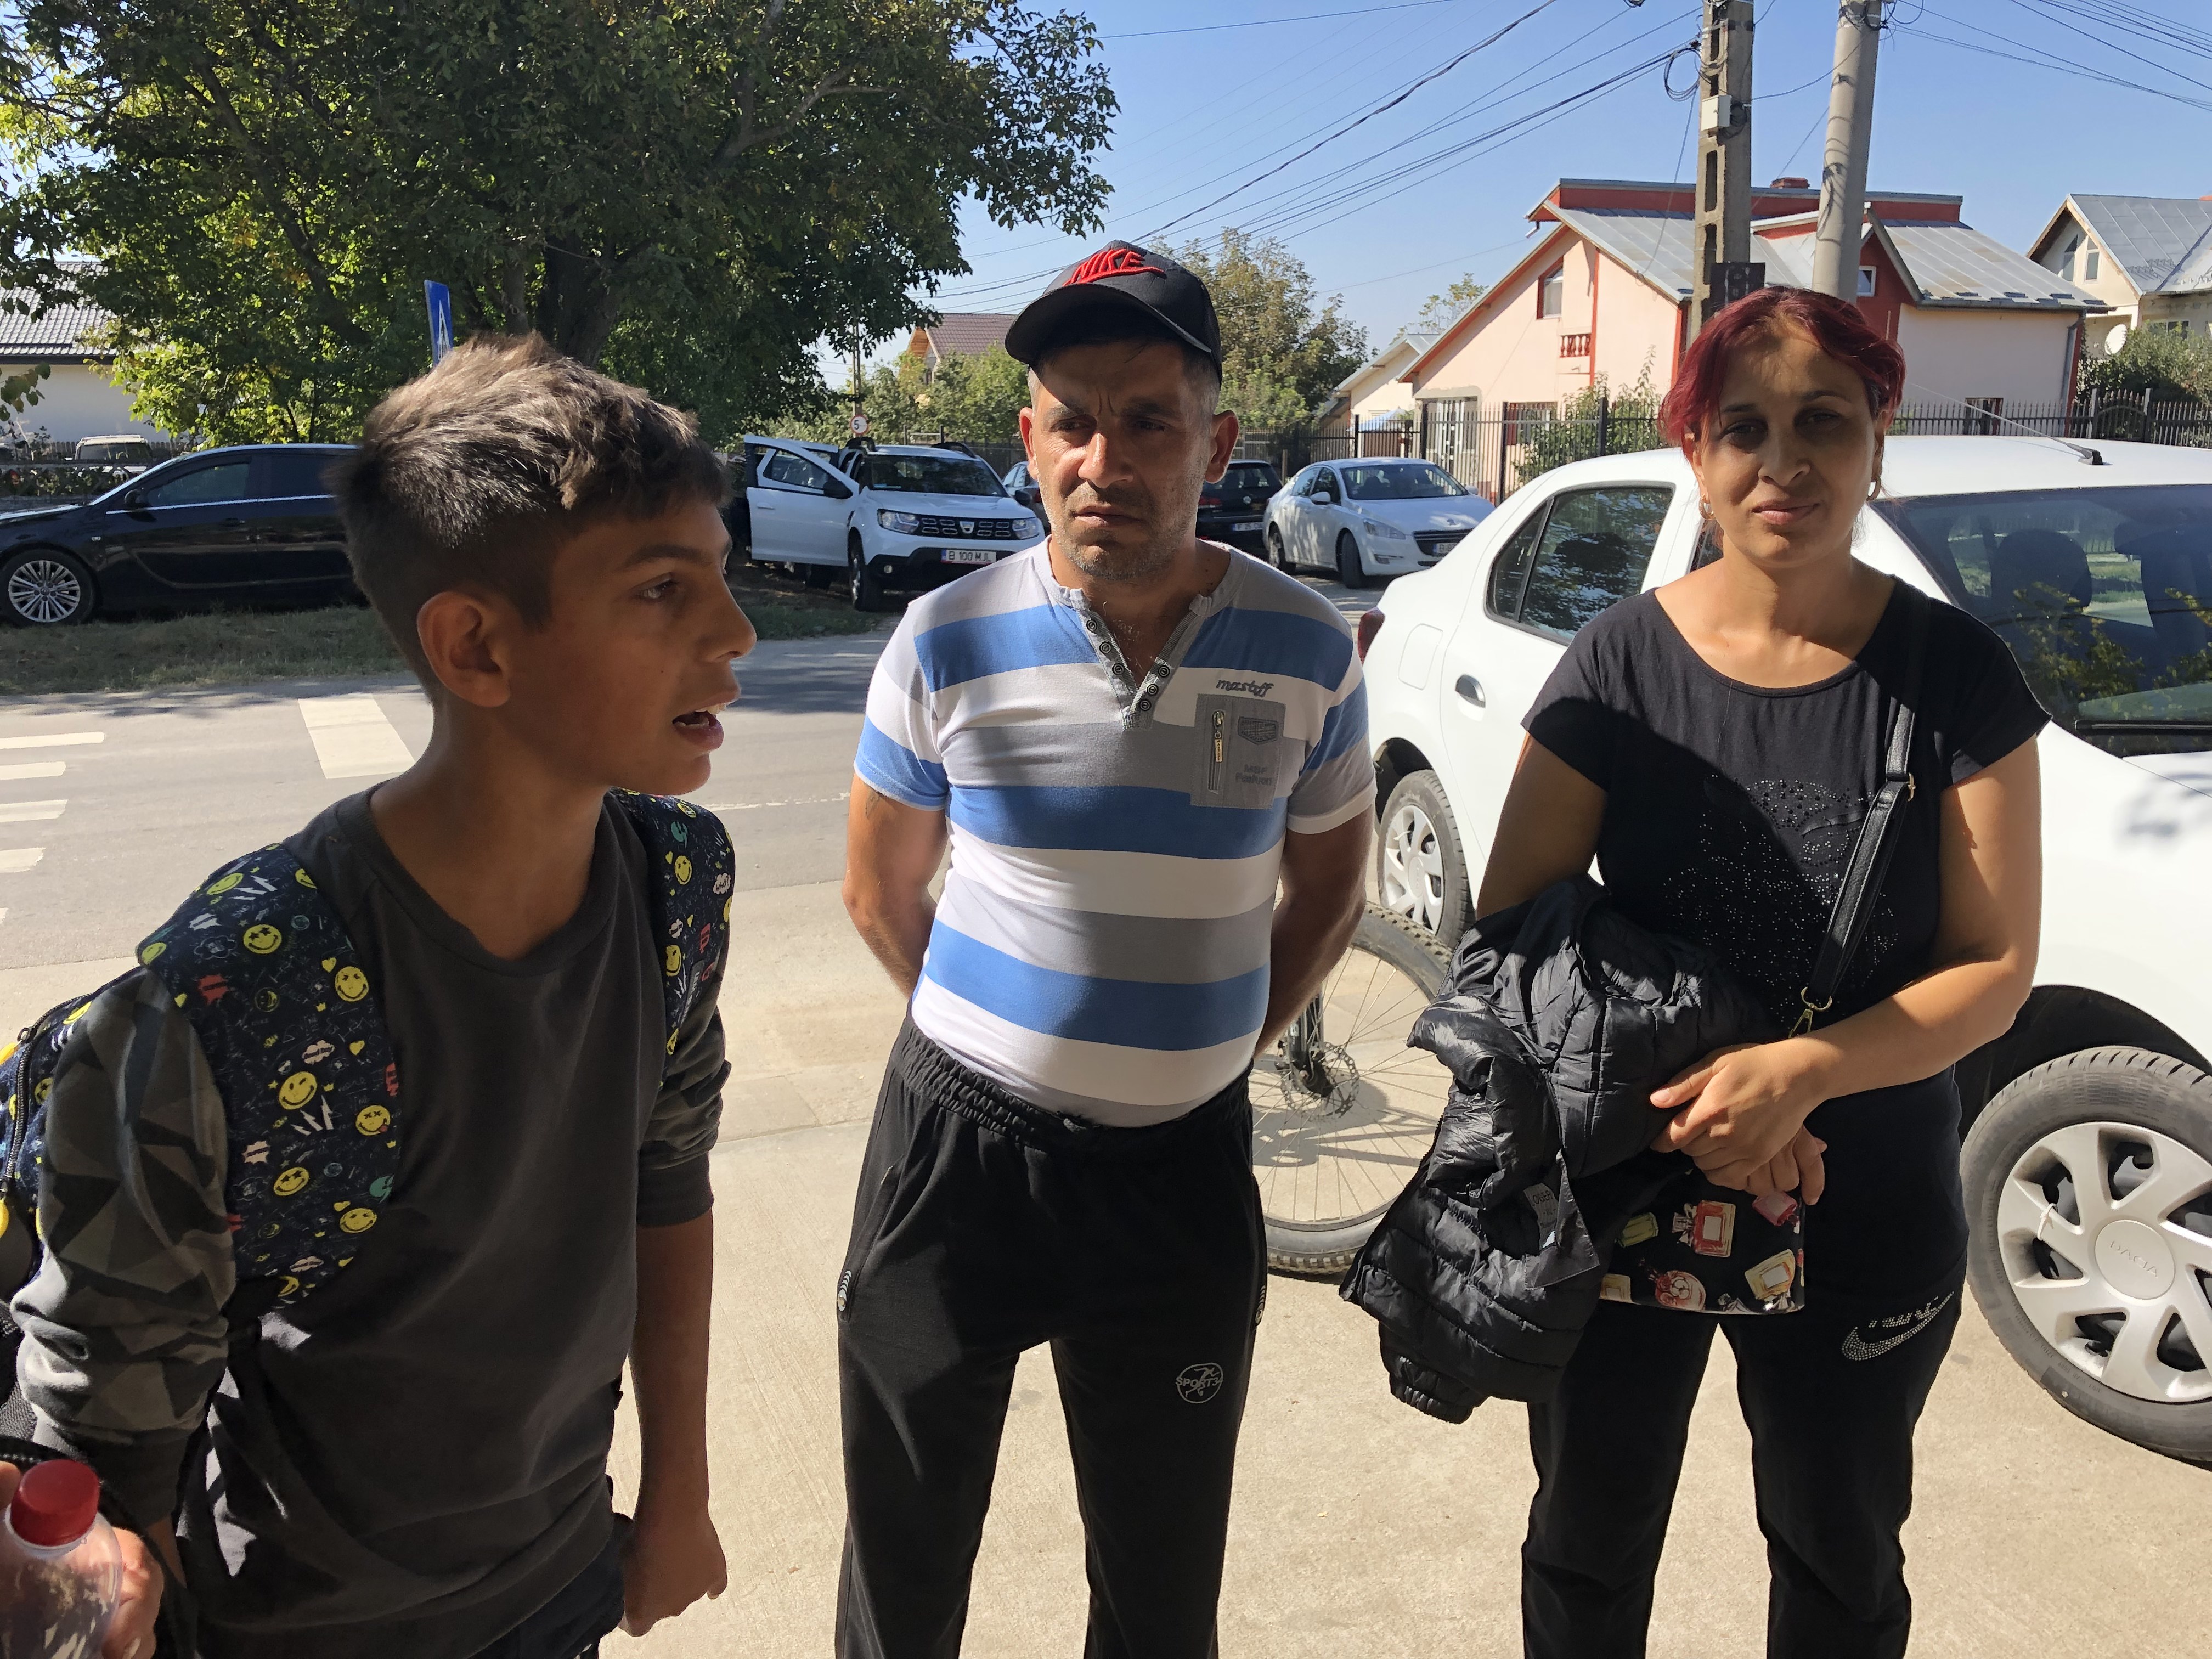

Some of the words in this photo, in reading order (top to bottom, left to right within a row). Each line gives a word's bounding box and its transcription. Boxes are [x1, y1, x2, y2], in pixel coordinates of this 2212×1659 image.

[1070, 249, 1146, 283] NIKE
[949, 551, 956, 560] B
[959, 551, 973, 561] 100
[2110, 1240, 2158, 1278] DACIA
